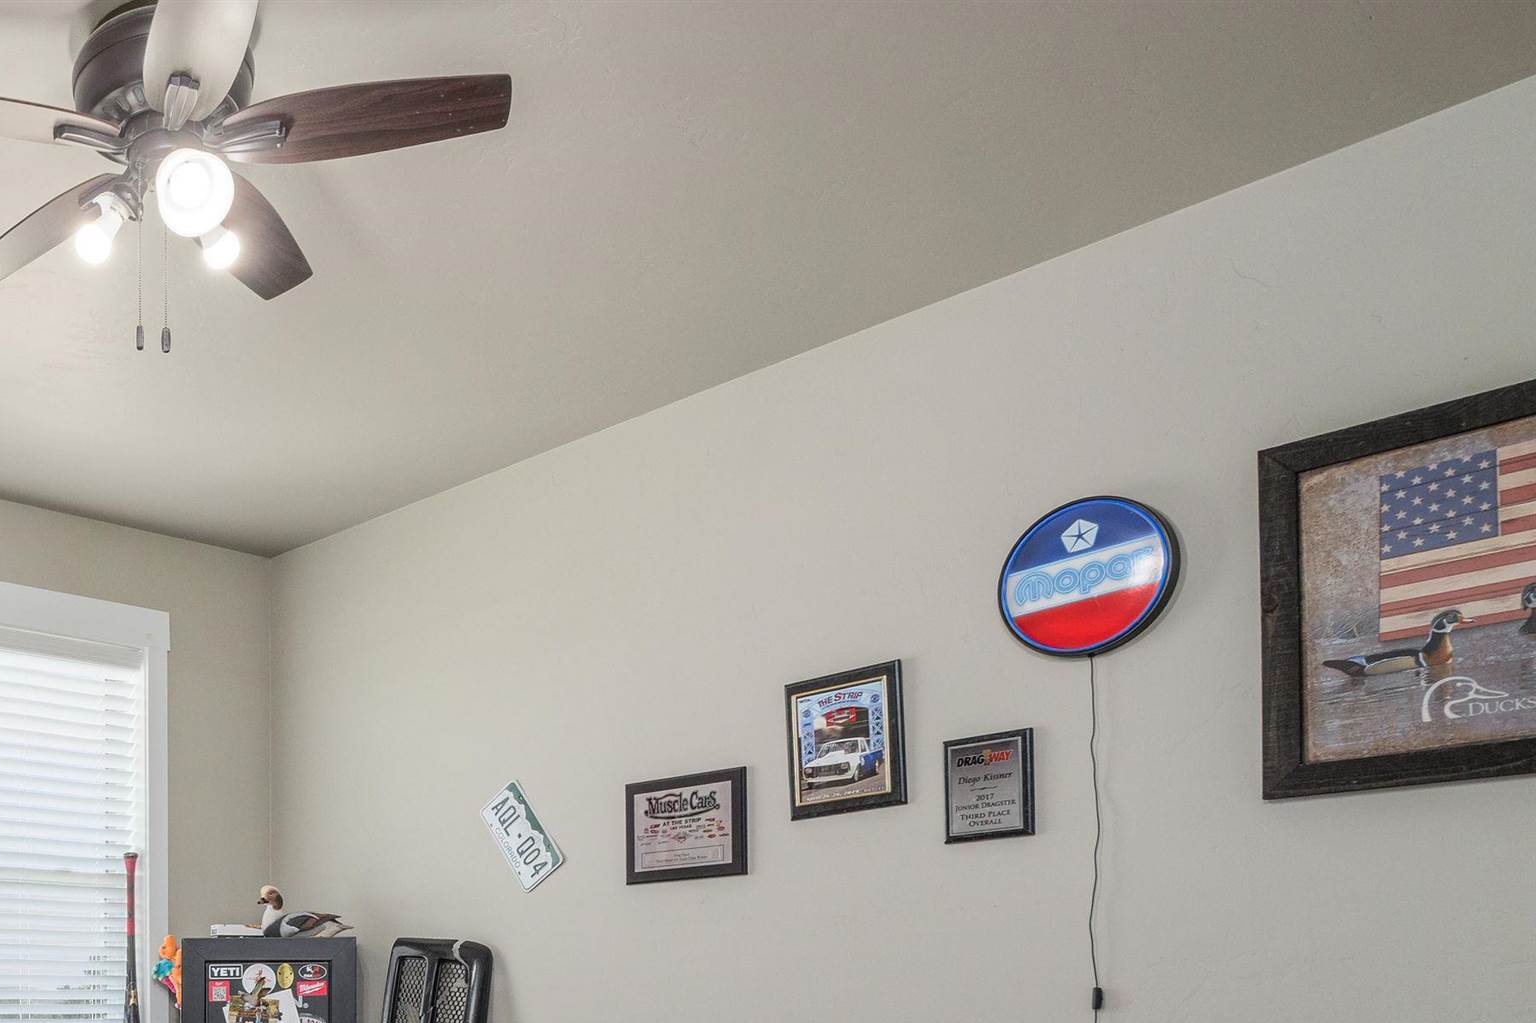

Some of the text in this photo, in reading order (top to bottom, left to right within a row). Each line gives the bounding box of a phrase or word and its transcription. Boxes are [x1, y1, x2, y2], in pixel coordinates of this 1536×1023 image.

[817, 695, 833, 708] THE
[834, 691, 863, 703] STRIP
[958, 776, 981, 787] Diego
[646, 792, 689, 815] Muscle
[976, 793, 994, 802] 2017
[960, 809, 1010, 821] THIRD PLACE
[495, 827, 520, 869] COLORADO
[211, 967, 240, 977] YETI
